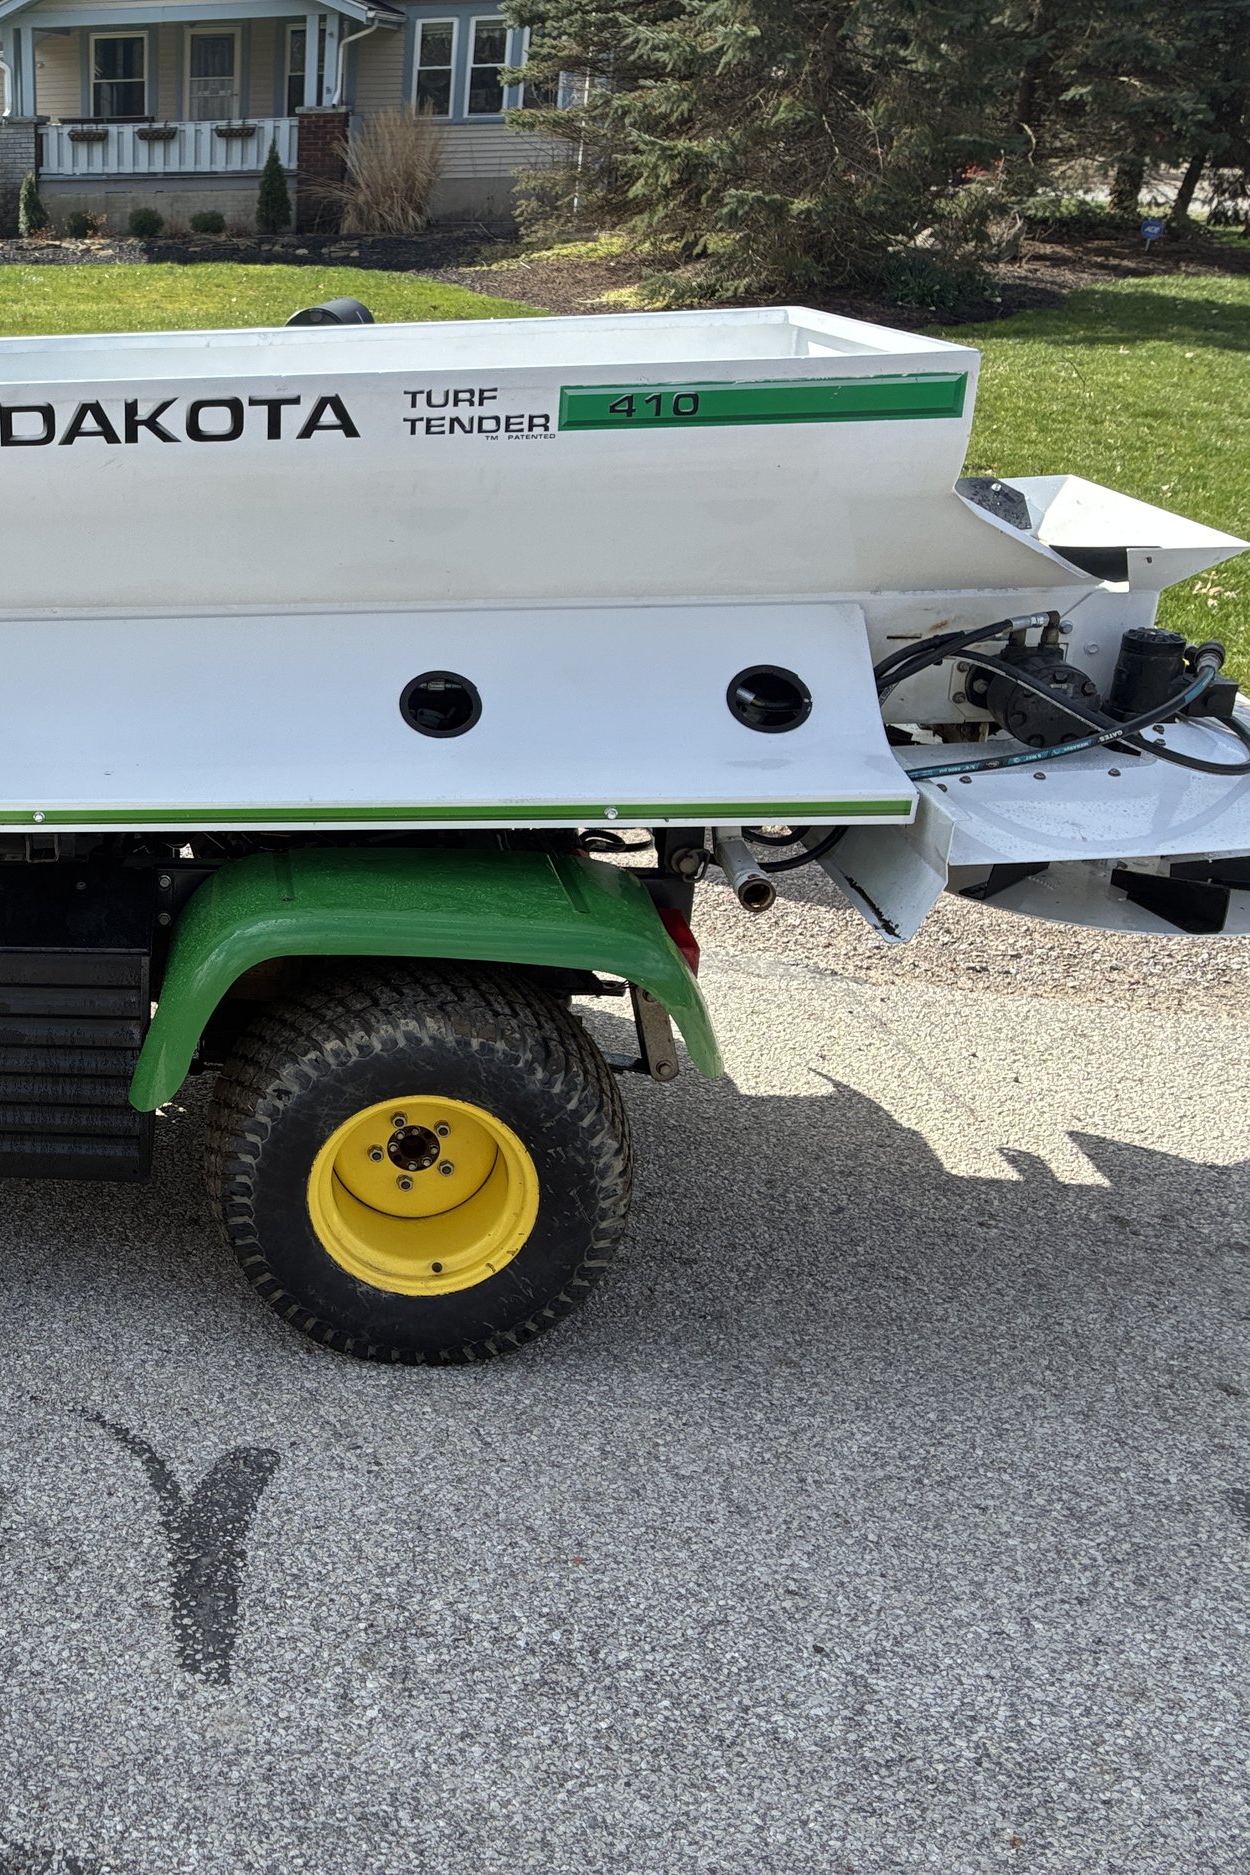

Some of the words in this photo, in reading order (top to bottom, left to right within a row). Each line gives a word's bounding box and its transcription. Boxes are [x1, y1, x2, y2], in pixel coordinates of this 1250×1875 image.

[403, 387, 498, 409] TURF
[609, 392, 700, 418] 410
[0, 393, 361, 447] DAKOTA
[403, 413, 550, 436] TENDER
[507, 433, 556, 441] PATENTED
[1098, 730, 1124, 743] GATES
